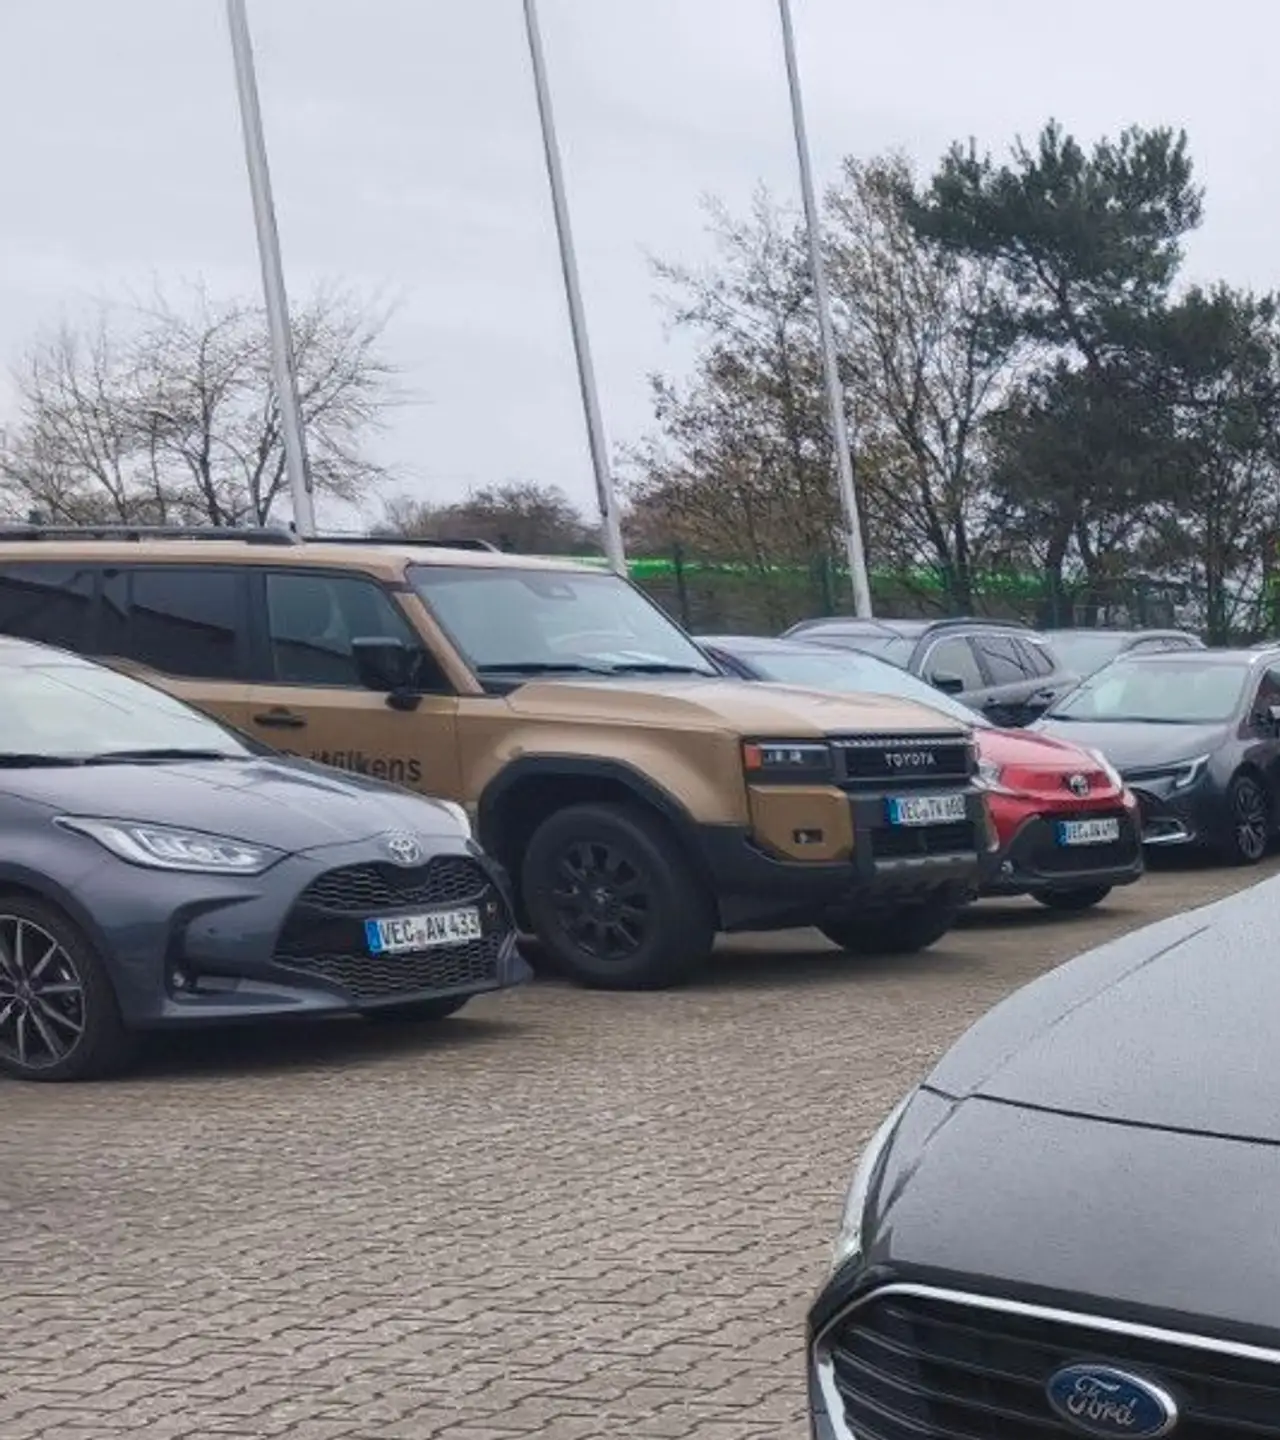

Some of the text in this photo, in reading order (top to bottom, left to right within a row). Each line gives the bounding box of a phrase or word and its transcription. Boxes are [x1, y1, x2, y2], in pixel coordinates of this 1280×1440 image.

[885, 751, 936, 767] TOYOTA
[381, 919, 415, 946] VEC
[426, 915, 449, 940] AW
[1067, 1375, 1137, 1426] Ford
